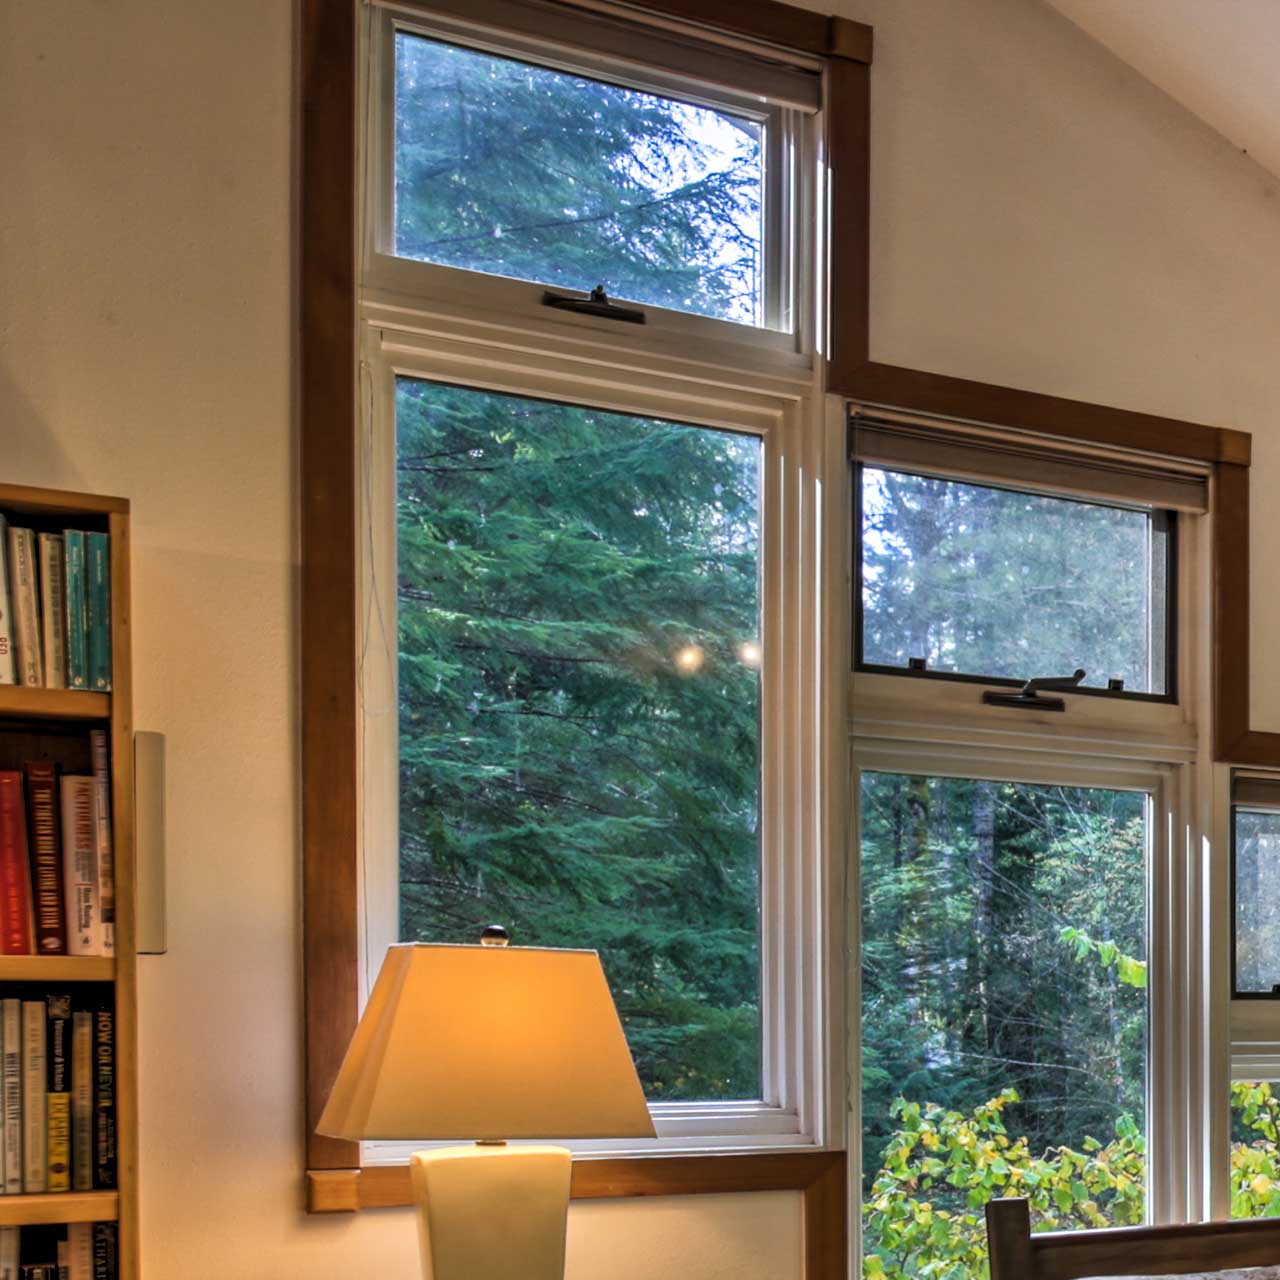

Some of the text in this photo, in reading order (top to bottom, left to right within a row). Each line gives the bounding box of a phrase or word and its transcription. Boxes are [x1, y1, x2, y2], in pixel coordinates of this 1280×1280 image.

[98, 1012, 112, 1044] NOW
[98, 1045, 112, 1064] OR
[98, 1066, 112, 1106] NEVER
